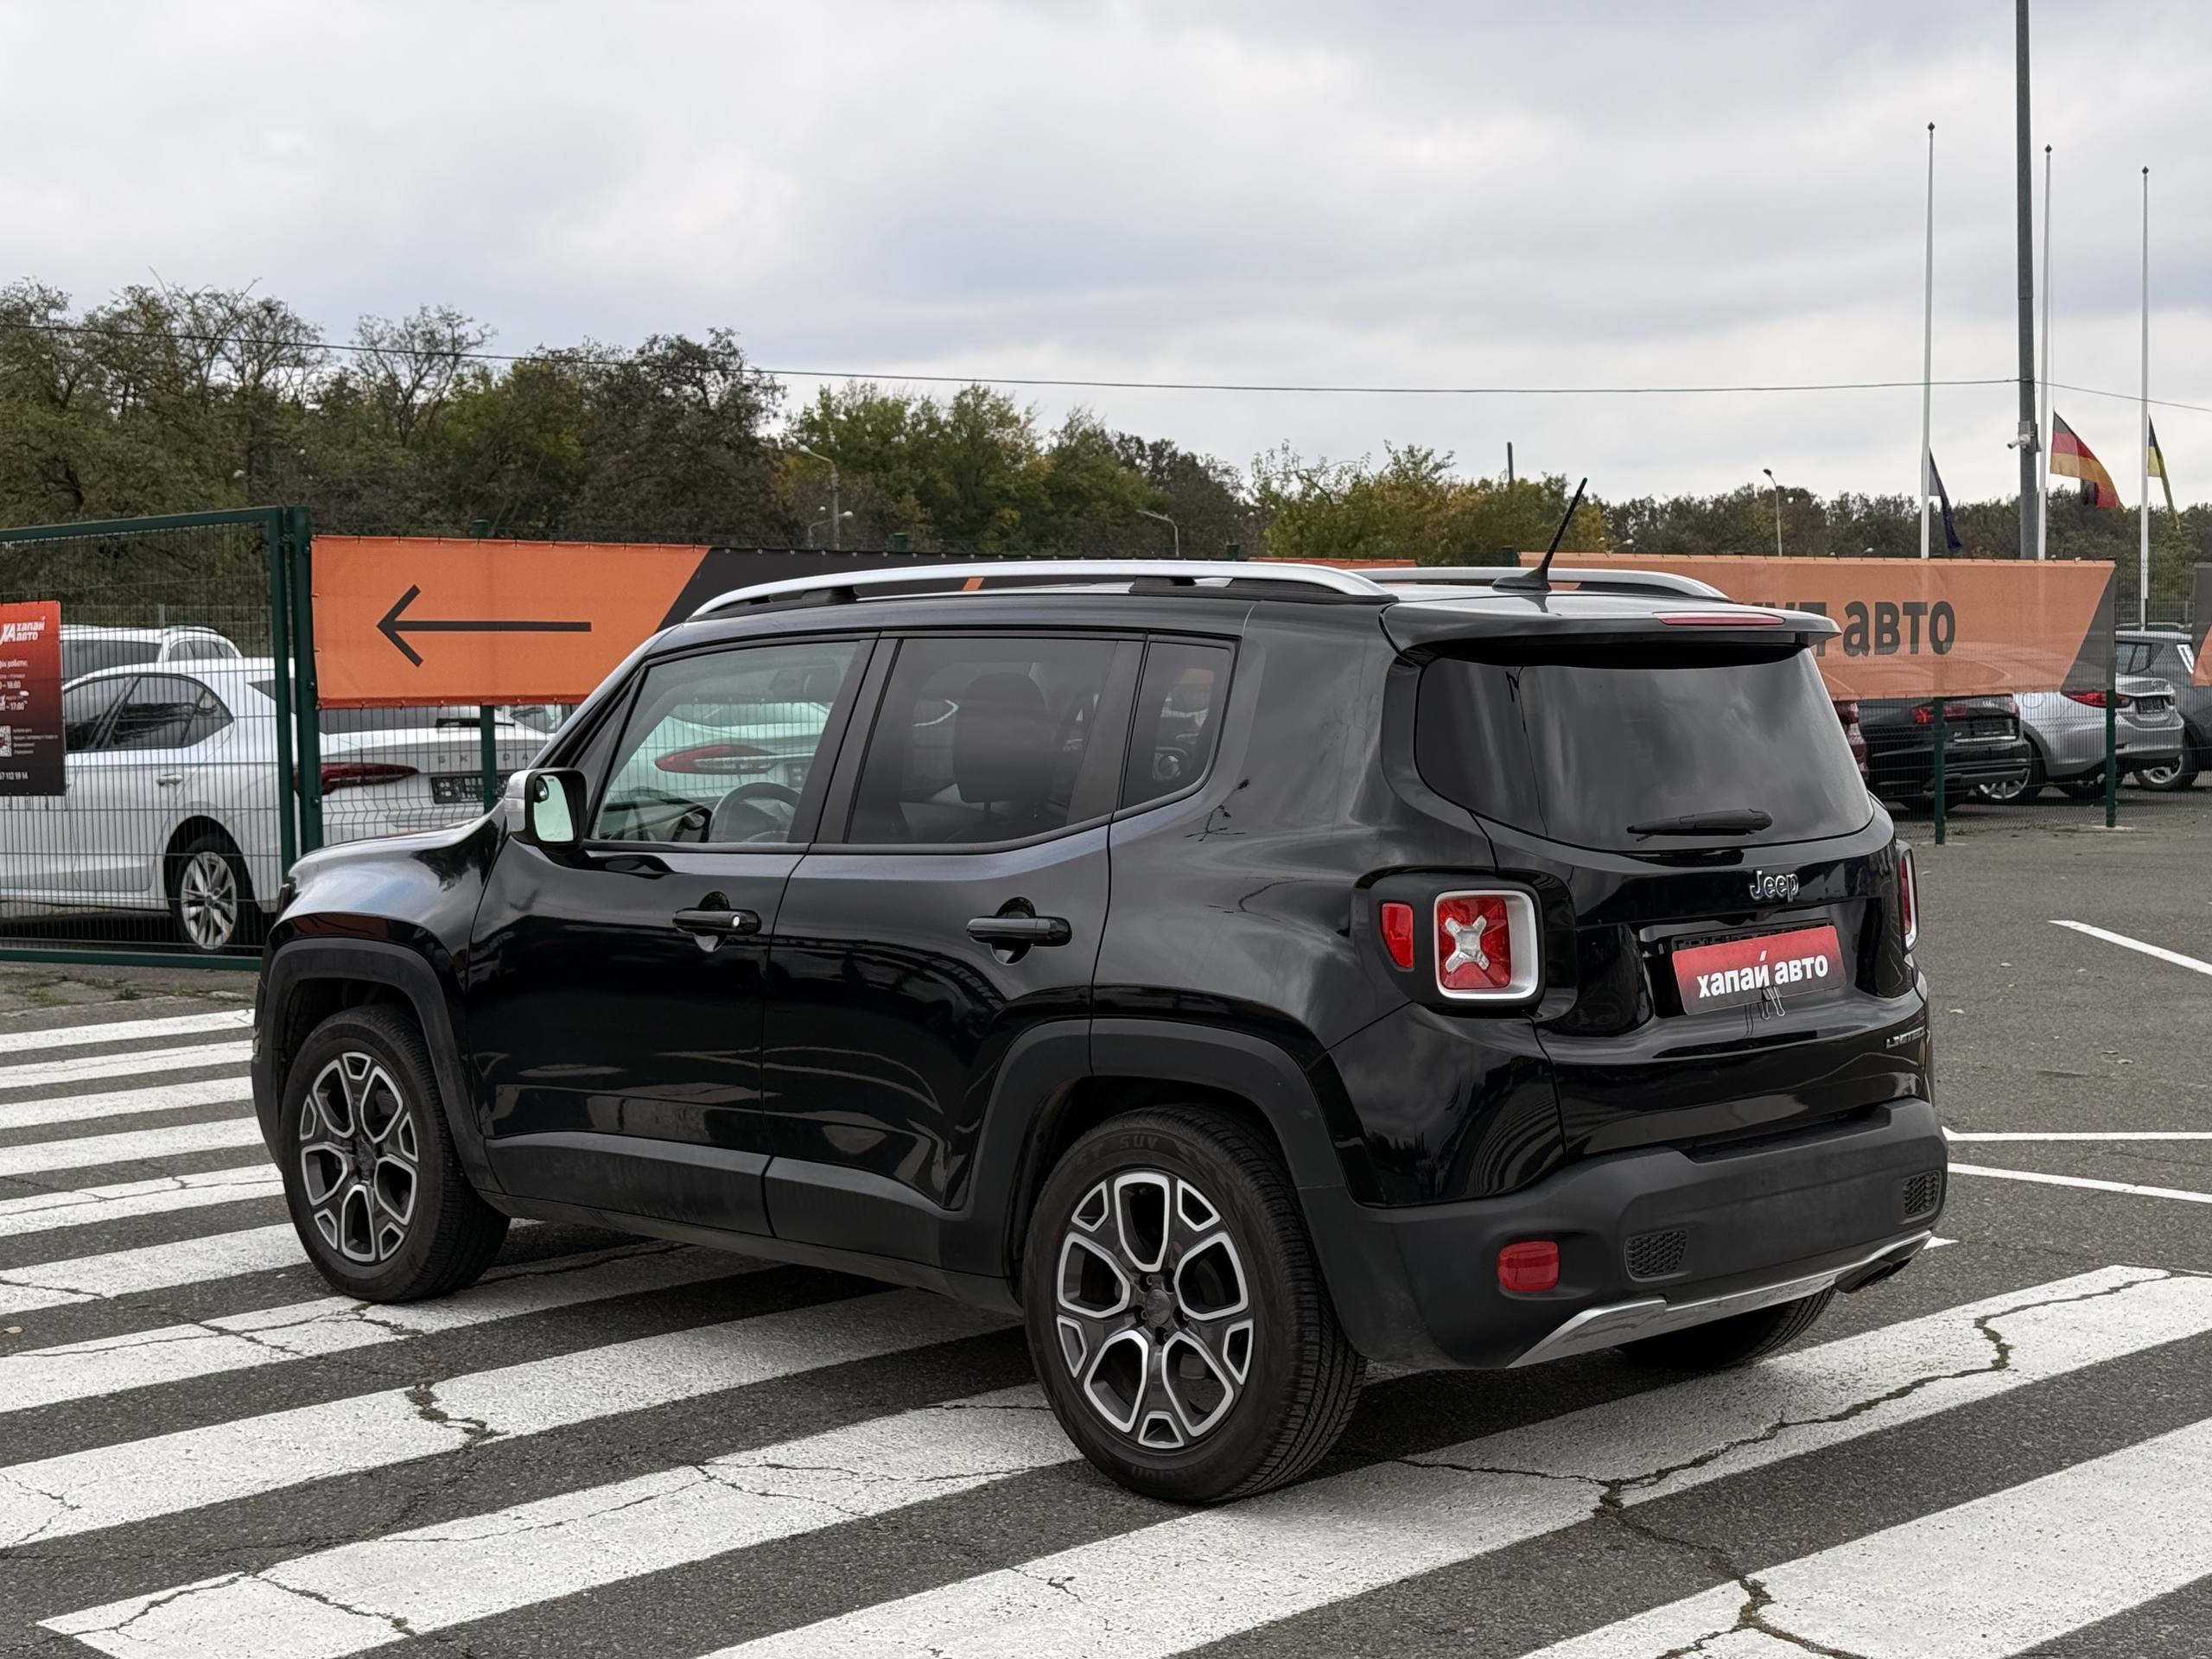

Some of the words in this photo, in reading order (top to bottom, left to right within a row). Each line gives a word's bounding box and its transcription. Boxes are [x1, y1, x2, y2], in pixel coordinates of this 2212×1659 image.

[1842, 601, 1956, 658] авто
[1750, 870, 1799, 902] Jeep
[1696, 950, 1770, 998] хапай
[1774, 954, 1828, 985] авто
